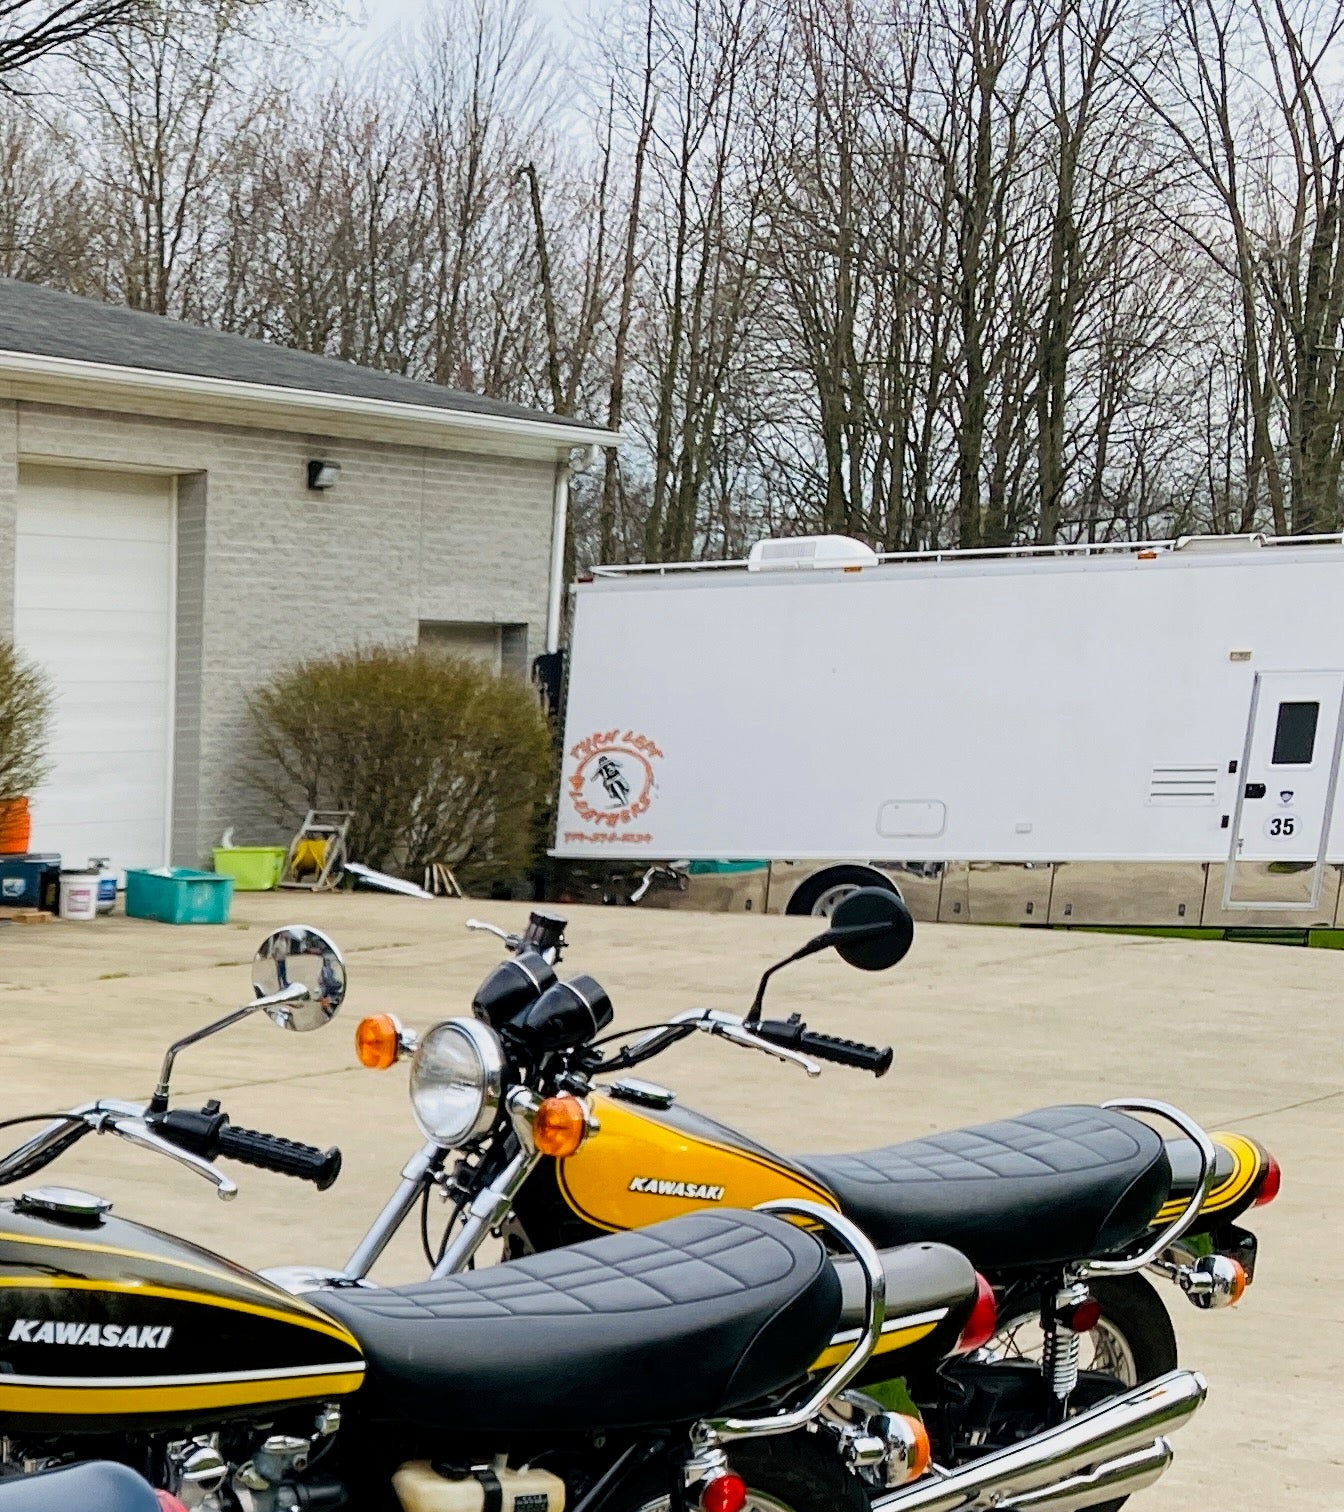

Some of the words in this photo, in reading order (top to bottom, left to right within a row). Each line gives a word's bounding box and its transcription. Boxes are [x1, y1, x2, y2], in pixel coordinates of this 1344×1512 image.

[1270, 818, 1294, 836] 35
[630, 1177, 725, 1201] KAWASAKI
[8, 1319, 173, 1349] KAWASAKI
